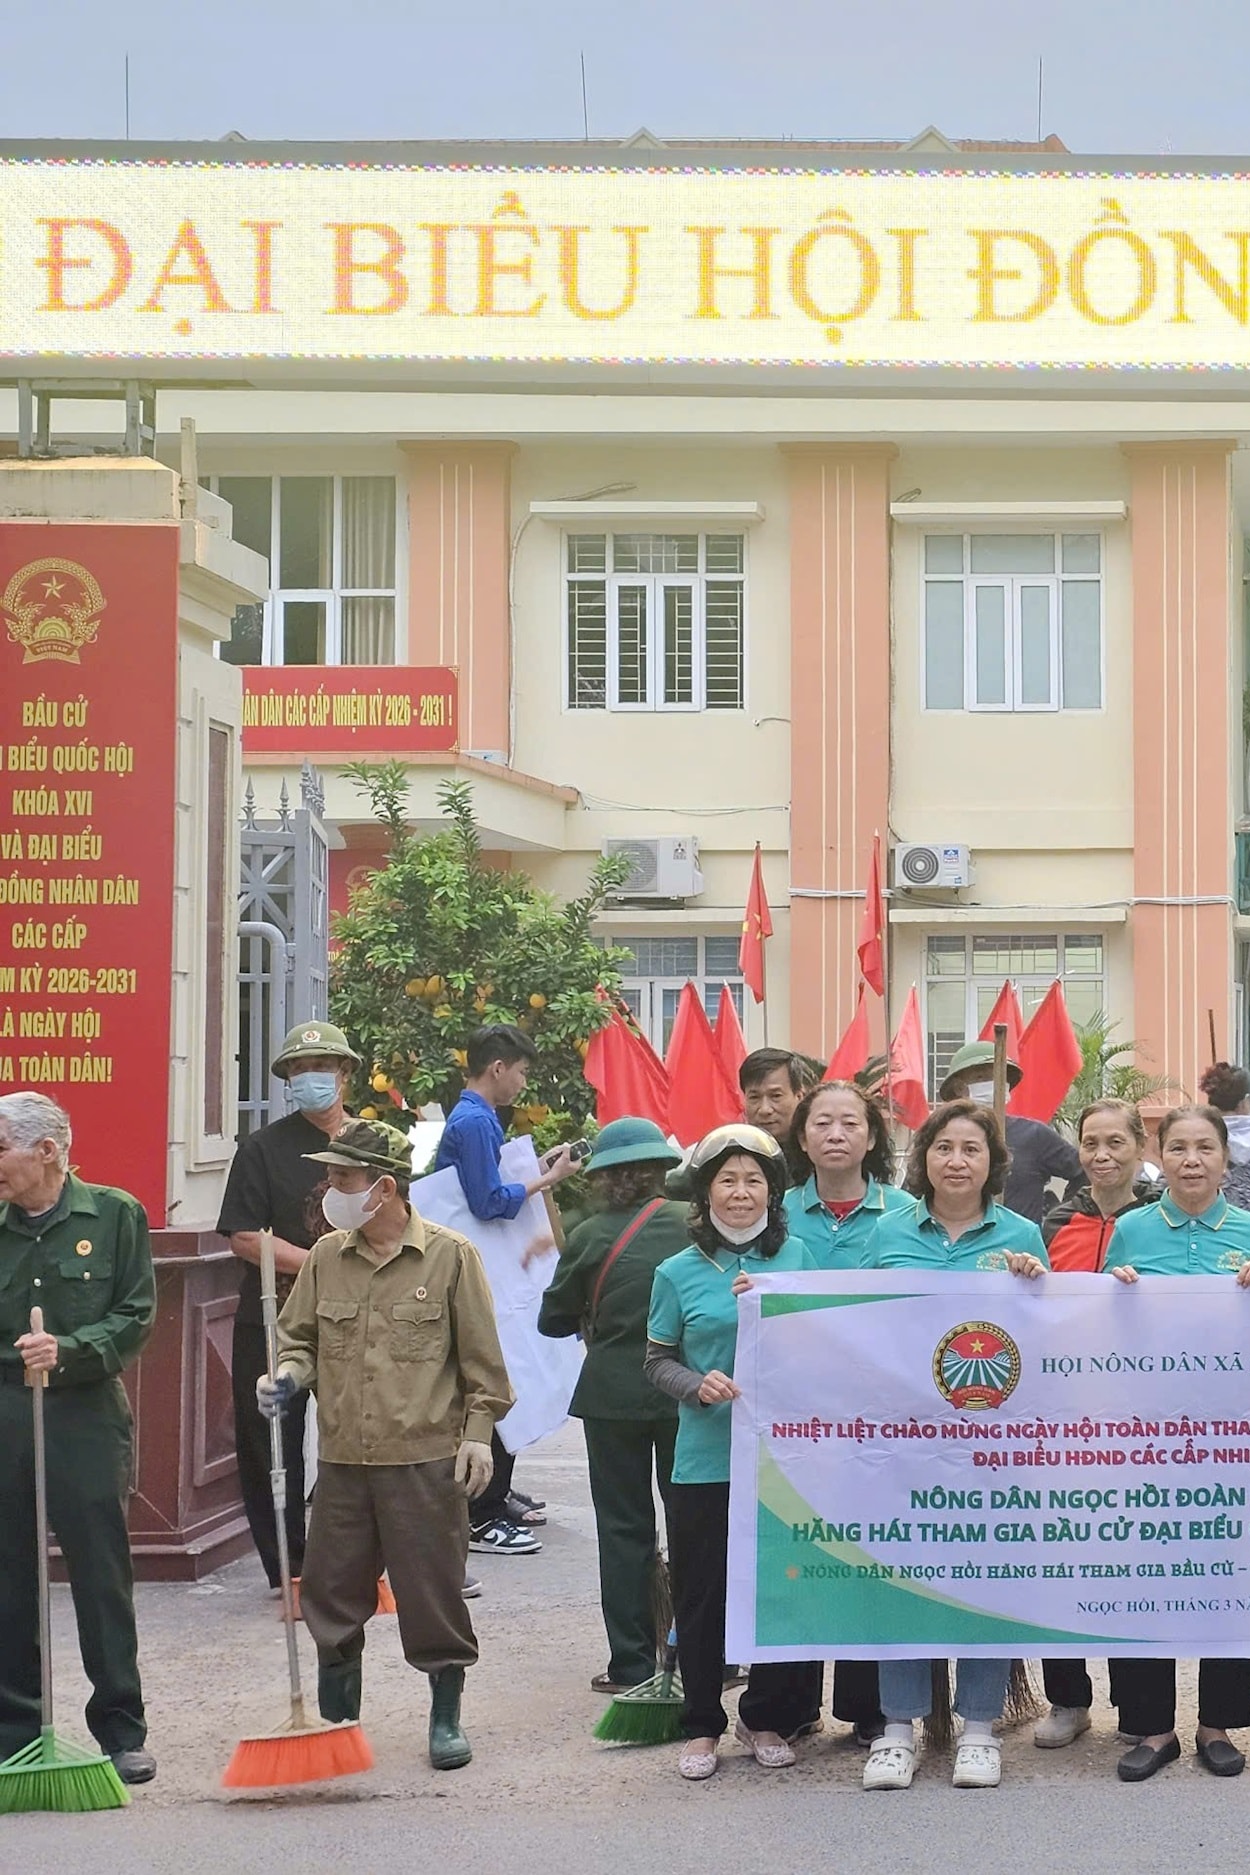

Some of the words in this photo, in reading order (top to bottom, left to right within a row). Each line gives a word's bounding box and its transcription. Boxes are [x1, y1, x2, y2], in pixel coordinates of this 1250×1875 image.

[34, 216, 284, 336] ĐẠI
[324, 189, 649, 321] BIỂU
[684, 207, 930, 345] HỘI
[22, 692, 58, 728] BẦU
[63, 694, 89, 728] CỬ
[261, 688, 283, 727] DÂN
[285, 688, 307, 727] CÁC
[309, 683, 330, 727] CẤP
[332, 688, 367, 733] NHIỆM
[369, 688, 384, 727] KỲ
[385, 694, 411, 727] 2026
[420, 694, 445, 727] 2031
[8, 736, 48, 771] BIỂU
[53, 738, 99, 774] QUỐC
[104, 742, 134, 777] HỘI
[12, 785, 59, 816] KHÓA
[64, 790, 93, 816] XVI
[1, 828, 23, 860] VÀ
[28, 834, 57, 865] ĐẠI
[62, 825, 103, 860] BIỂU
[49, 874, 98, 905] NHÂN
[103, 874, 139, 905] DÂN
[11, 918, 47, 949] CÁC
[52, 915, 87, 949] CẤP
[20, 962, 43, 993] KỲ
[47, 967, 137, 993] 2026-2031
[20, 1007, 66, 1038] NGÀY
[71, 1007, 101, 1043] HỘI
[19, 1051, 64, 1082] TOÀN
[69, 1053, 113, 1082] DÂN!
[1041, 1354, 1083, 1377] HỘI
[1090, 1352, 1154, 1373] NÔNG
[1161, 1351, 1207, 1372] DÂN
[1213, 1352, 1244, 1371] XÃ
[772, 1417, 833, 1443] NHIỆT
[837, 1417, 877, 1443] LIỆT
[880, 1417, 937, 1439] CHÀO
[941, 1417, 1002, 1439] MỪNG
[1006, 1417, 1059, 1439] NGÀY
[1063, 1416, 1101, 1443] HỘI
[1104, 1415, 1160, 1438] TOÀN
[1164, 1415, 1207, 1437] DÂN
[972, 1451, 1008, 1471] ĐẠI
[1013, 1439, 1060, 1467] BIỂU
[1065, 1450, 1127, 1466] HĐND
[1130, 1442, 1168, 1465] CÁC
[1170, 1438, 1210, 1464] CẤP
[910, 1485, 983, 1510] NÔNG
[990, 1485, 1042, 1509] DÂN
[1048, 1488, 1118, 1513] NGỌC
[1124, 1482, 1170, 1508] HỒI
[1175, 1482, 1246, 1508] ĐOÀN
[792, 1518, 862, 1543] HĂNG
[869, 1518, 912, 1542] HÁI
[917, 1522, 987, 1543] THAM
[993, 1522, 1037, 1543] GIA
[1042, 1516, 1091, 1542] BẦU
[1098, 1515, 1134, 1541] CỬ
[1139, 1521, 1182, 1545] ĐẠI
[1189, 1513, 1243, 1541] BIỂU
[856, 1562, 894, 1579] DÂN
[899, 1565, 946, 1581] NGỌC
[987, 1562, 1037, 1579] HĂNG
[1042, 1562, 1074, 1578] HÁI
[1078, 1563, 1131, 1578] THAM
[1136, 1563, 1166, 1577] GIA
[1077, 1601, 1122, 1615] NGỌC
[1164, 1597, 1219, 1612] THÁNG
[1223, 1600, 1231, 1611] 3
